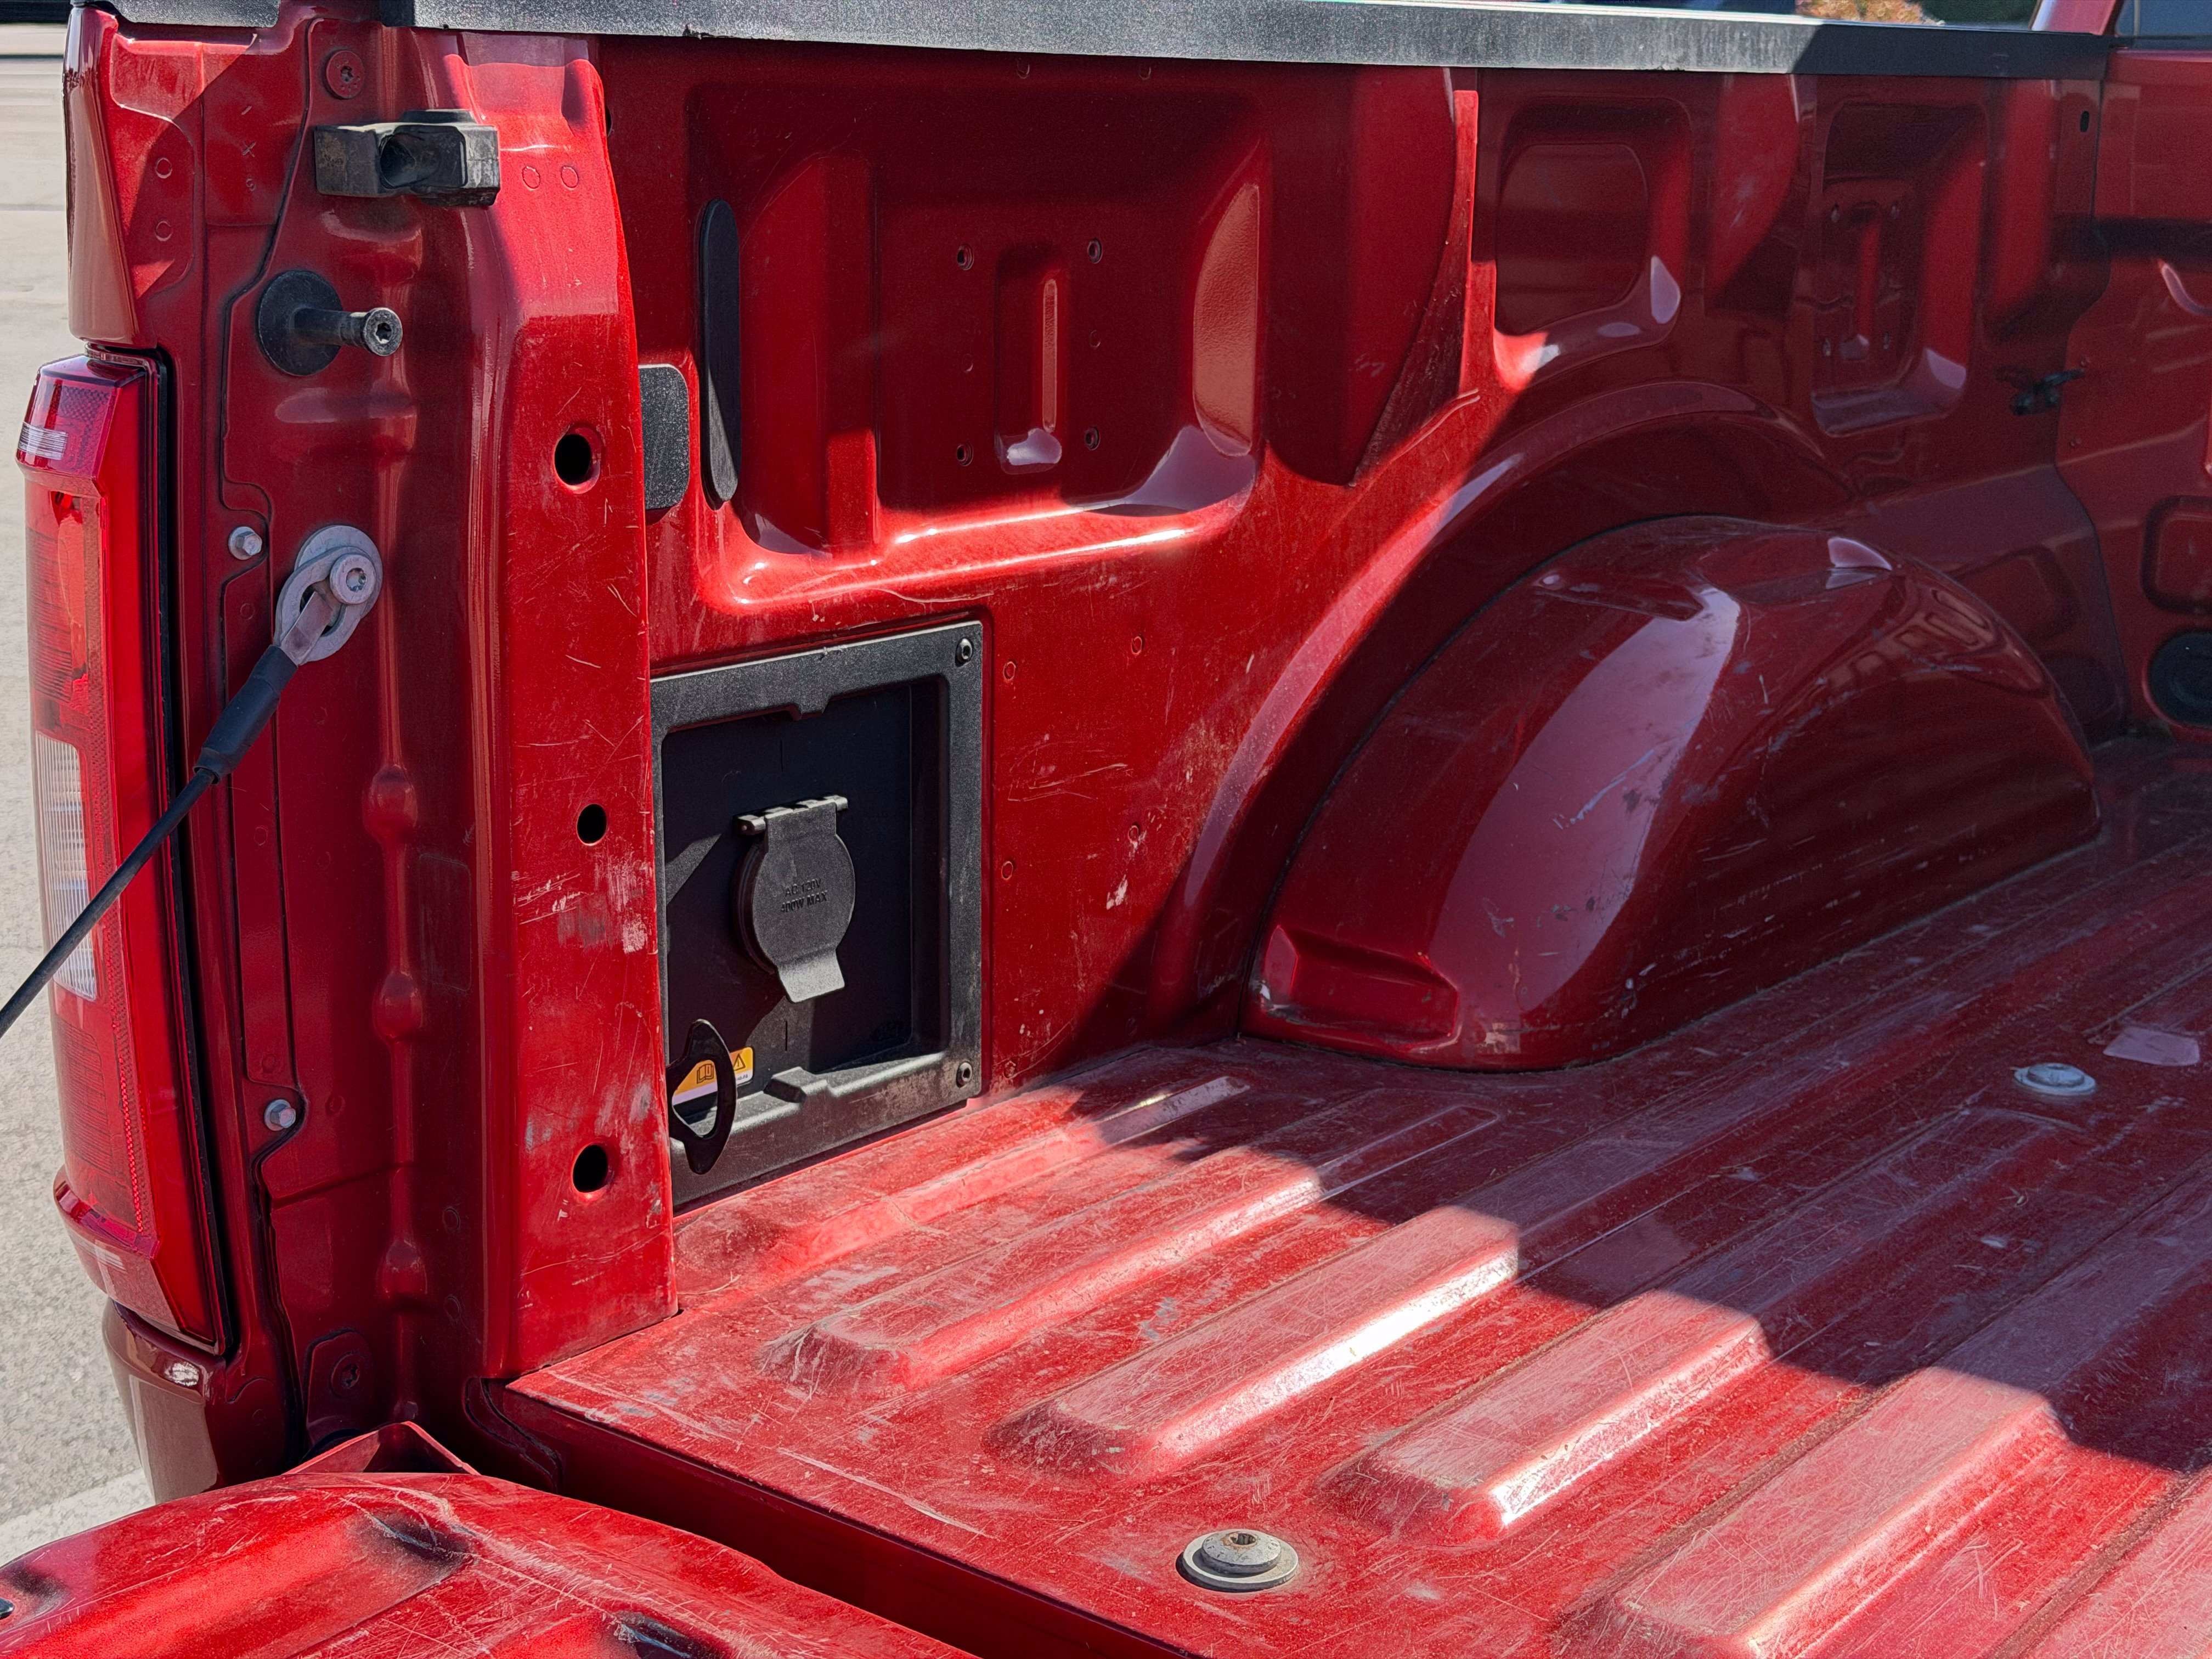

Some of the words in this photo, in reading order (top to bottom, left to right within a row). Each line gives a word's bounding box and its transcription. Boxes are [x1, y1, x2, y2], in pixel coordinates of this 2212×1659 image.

[785, 883, 798, 896] AC
[801, 878, 821, 893] 120V
[781, 896, 805, 912] 400W
[807, 890, 827, 907] MAX
